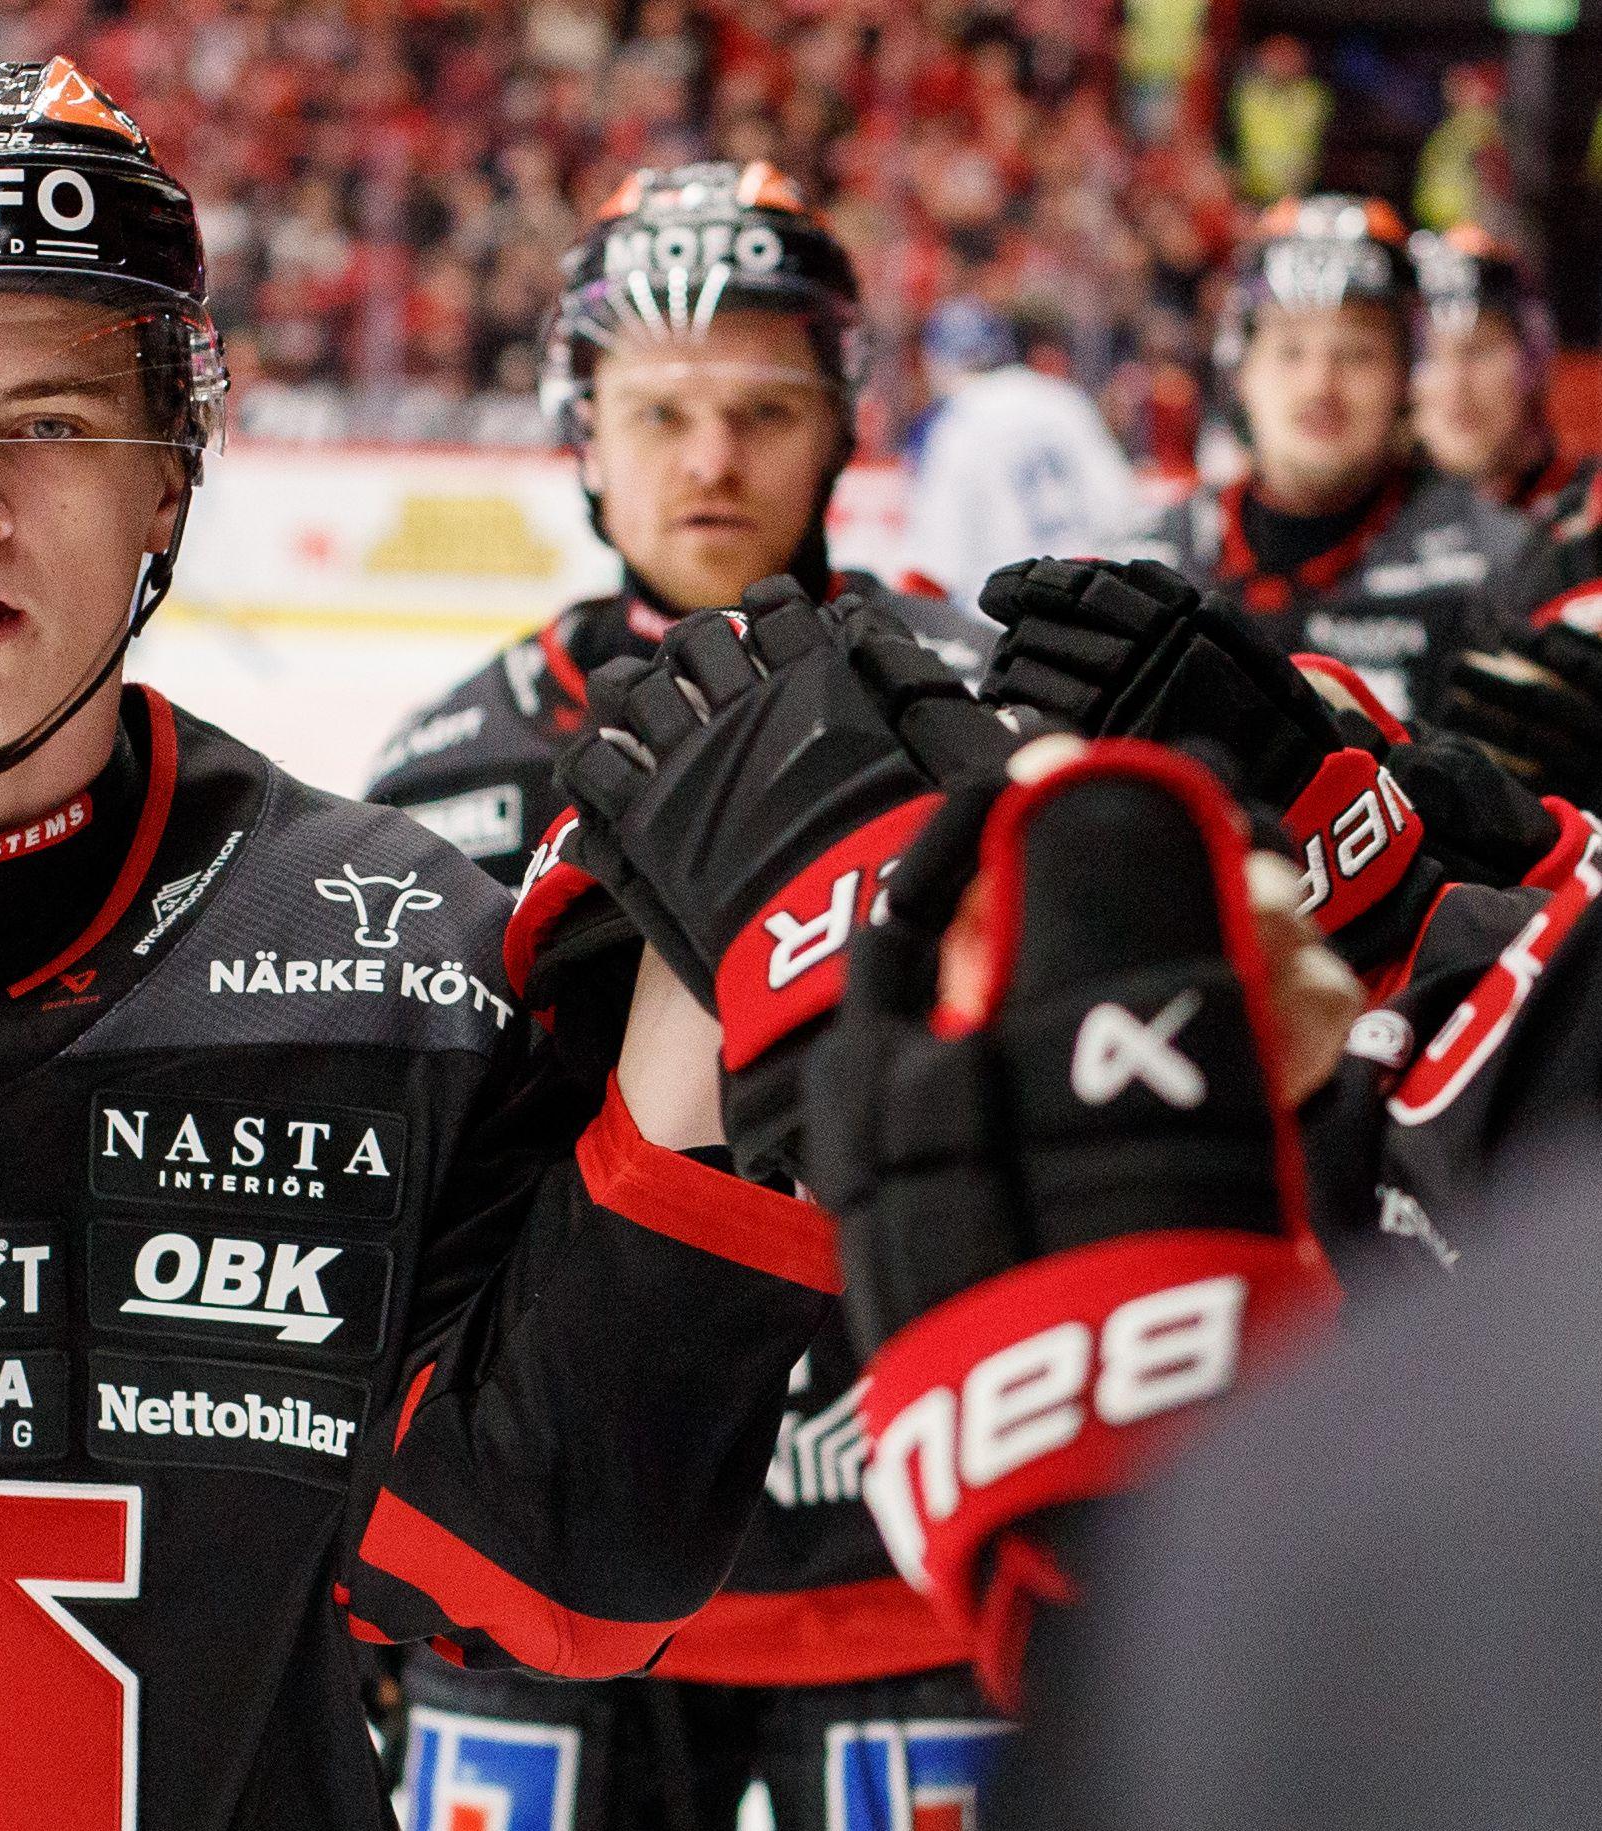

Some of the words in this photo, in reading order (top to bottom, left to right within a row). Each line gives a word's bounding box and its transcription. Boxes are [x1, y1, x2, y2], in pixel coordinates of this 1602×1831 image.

[132, 830, 244, 956] BYGGPRODUKTION
[209, 950, 386, 994] NÄRKE
[400, 960, 514, 1030] KÖTT
[101, 1108, 391, 1177] NASTA
[158, 1169, 326, 1199] INTERIÖR
[133, 1232, 344, 1315] OBK
[98, 1382, 356, 1458] Nettobilar
